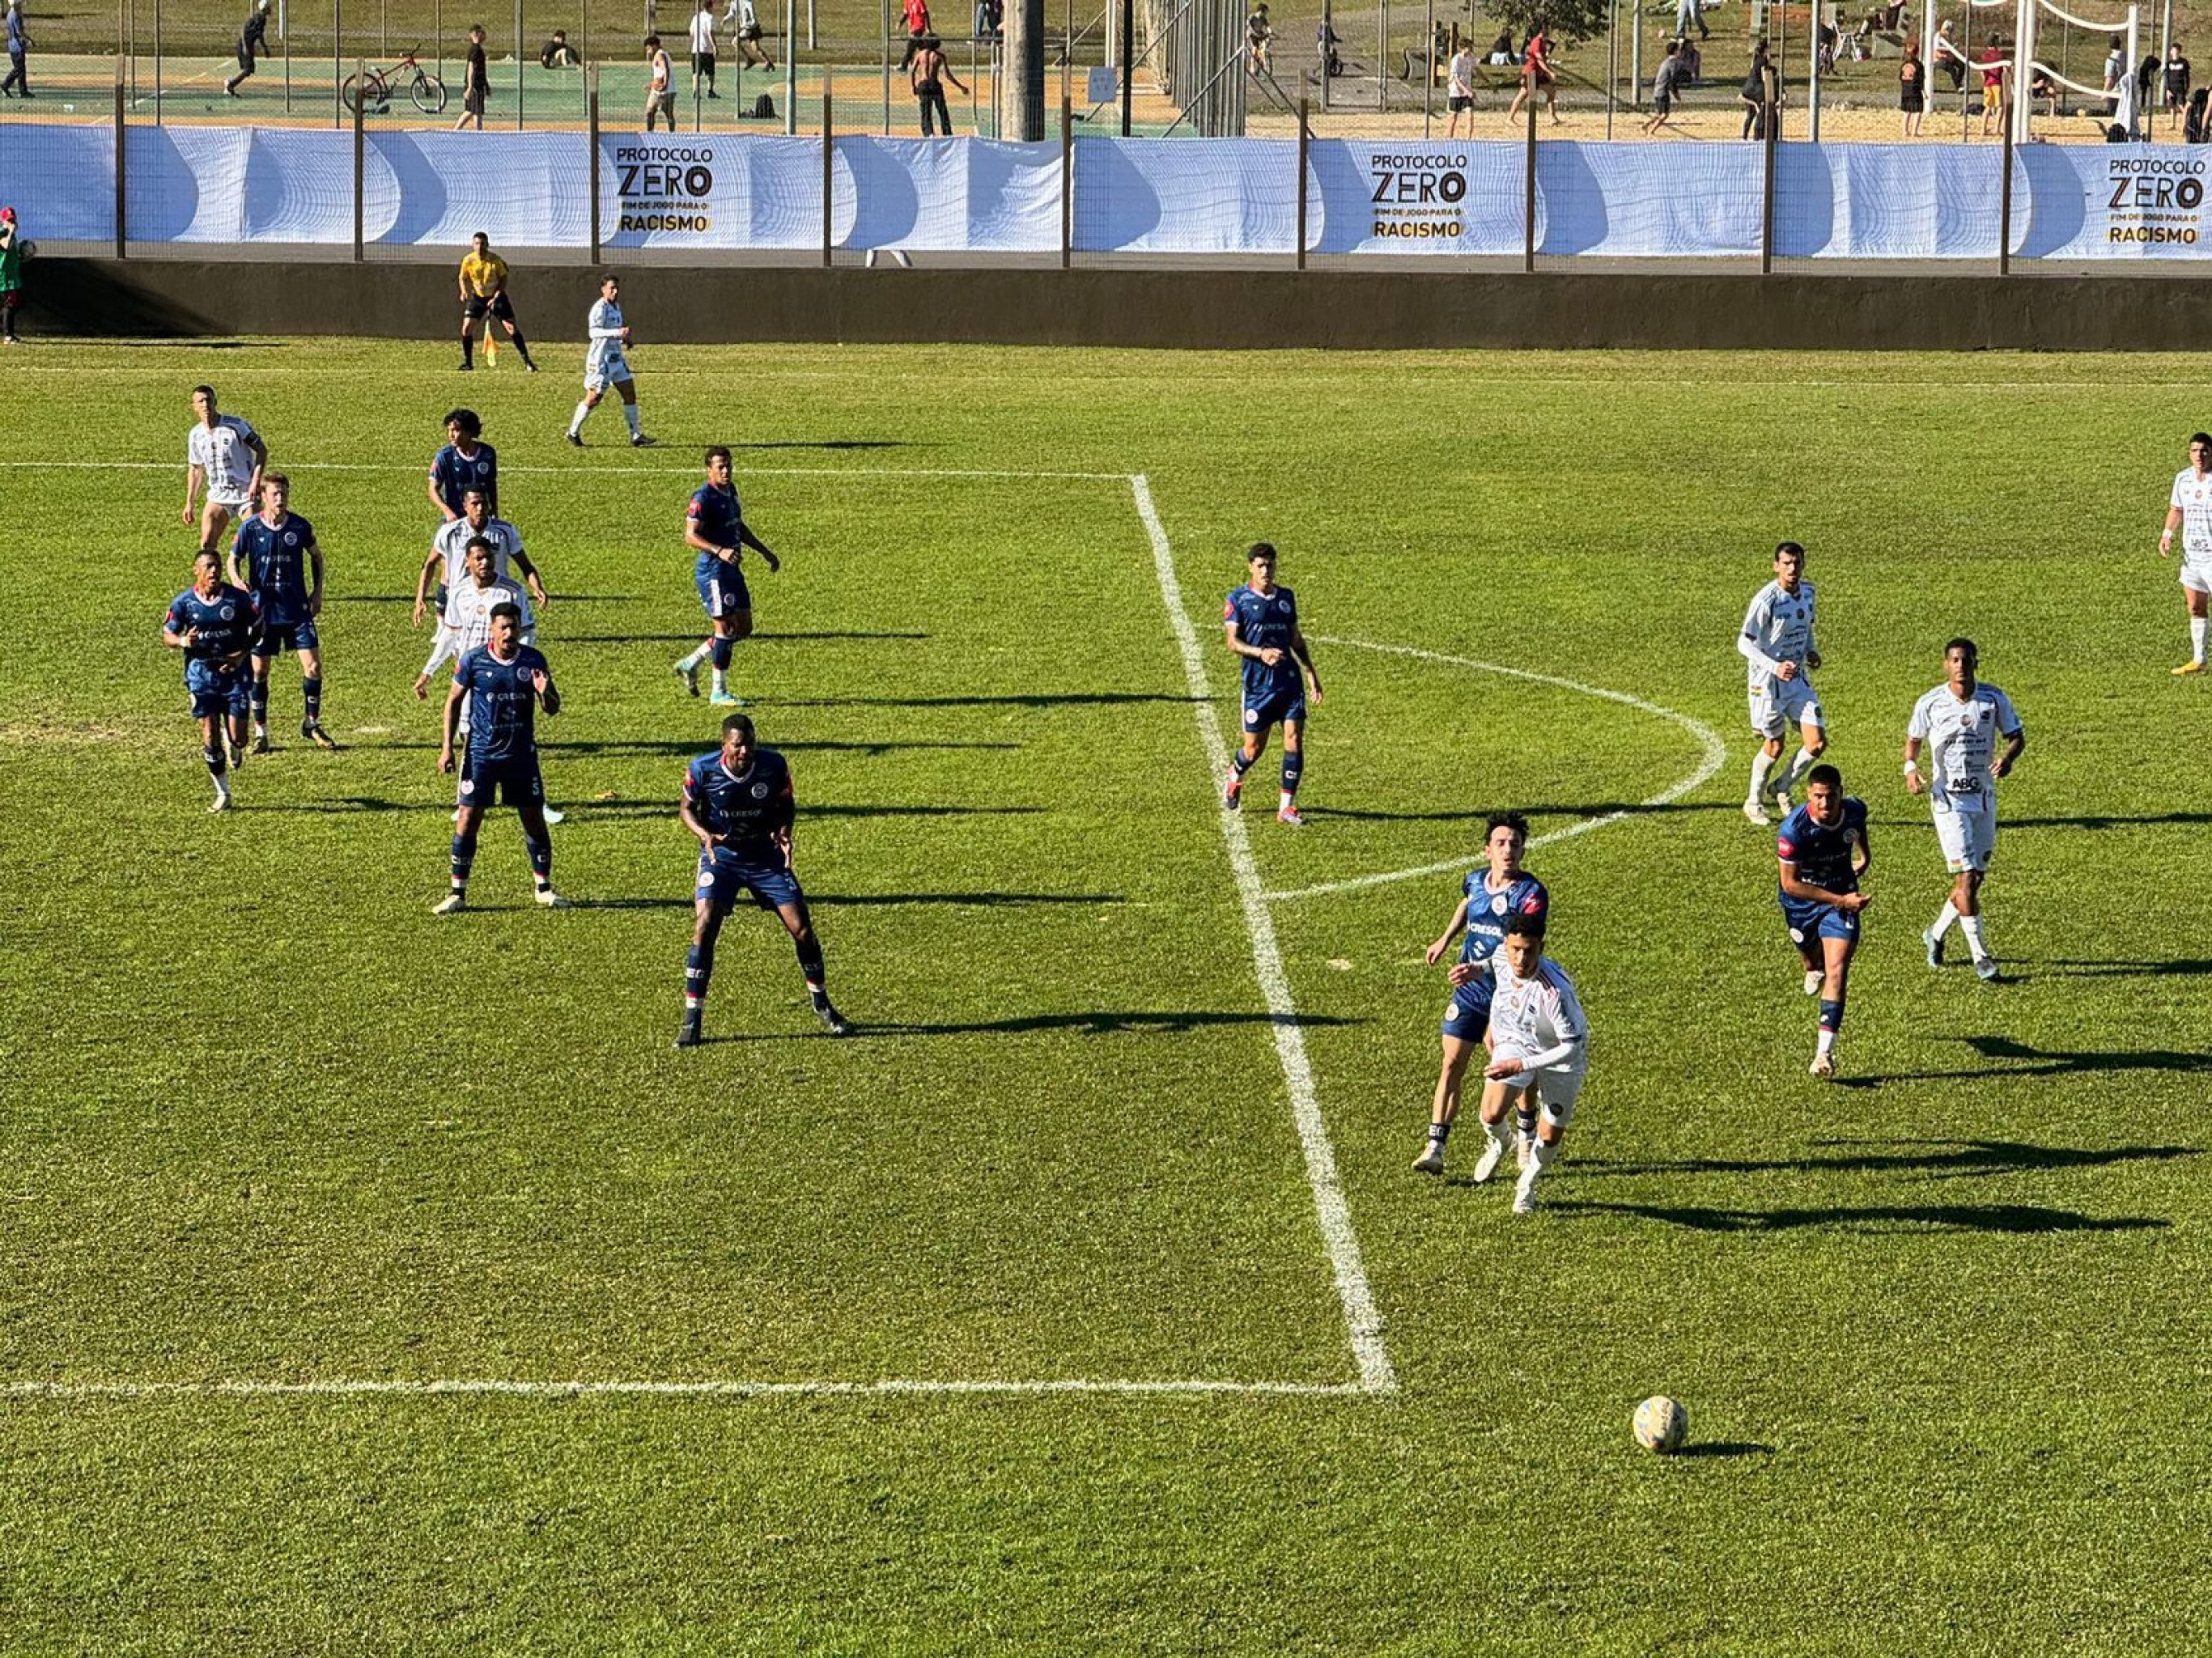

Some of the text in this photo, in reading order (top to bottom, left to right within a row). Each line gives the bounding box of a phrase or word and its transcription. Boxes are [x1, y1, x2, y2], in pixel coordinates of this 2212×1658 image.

[617, 147, 712, 162] PROTOCOLO
[1372, 155, 1467, 169] PROTOCOLO
[2110, 159, 2206, 174] PROTOCOLO
[617, 165, 712, 197] ZERO
[1371, 171, 1467, 203] ZERO
[2108, 177, 2203, 209] ZERO
[621, 214, 707, 231] RACISMO
[2166, 214, 2189, 222] PARA
[1373, 221, 1459, 238] RACISMO
[2110, 227, 2196, 244] RACISMO
[1953, 777, 1981, 791] ABG
